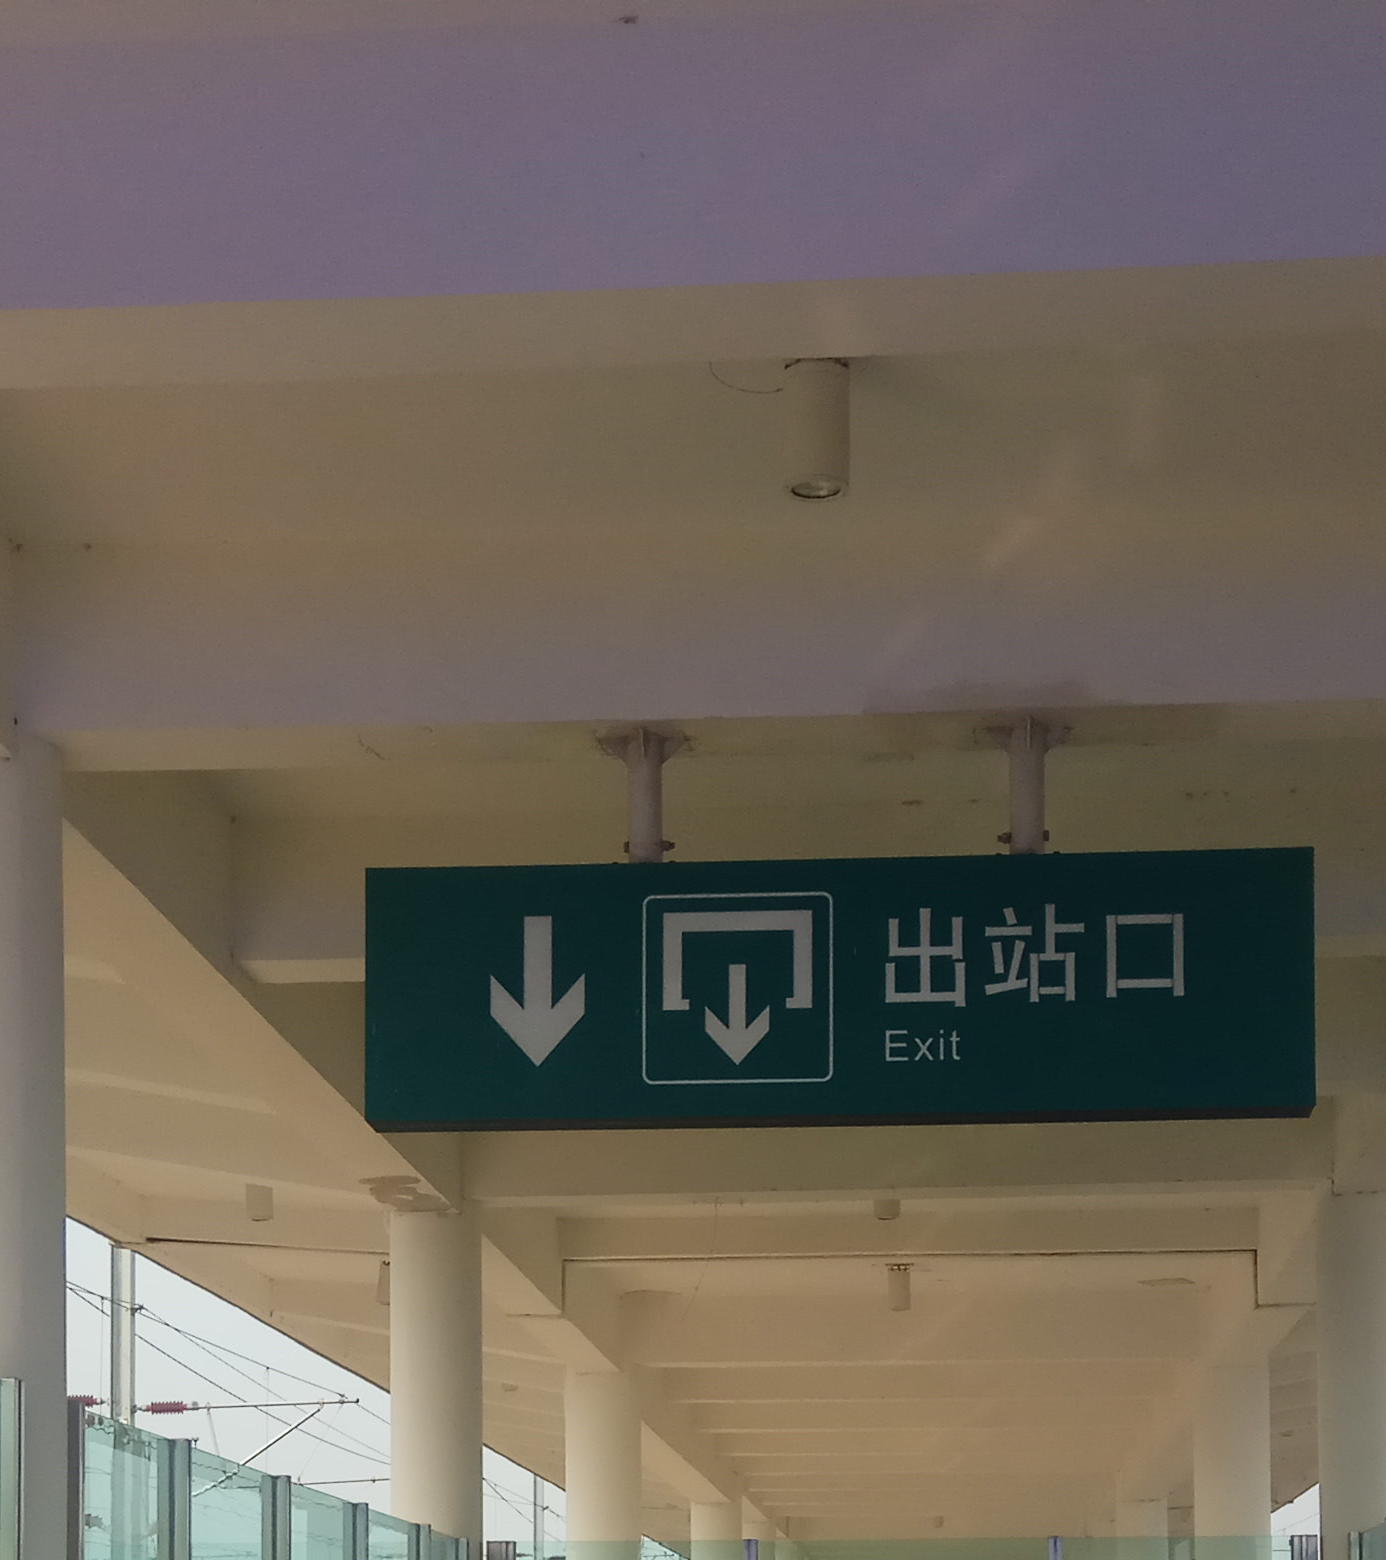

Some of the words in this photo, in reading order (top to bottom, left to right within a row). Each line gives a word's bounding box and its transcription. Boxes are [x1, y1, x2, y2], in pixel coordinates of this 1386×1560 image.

[883, 902, 1187, 1009] 出站口
[883, 1029, 962, 1063] Exit
